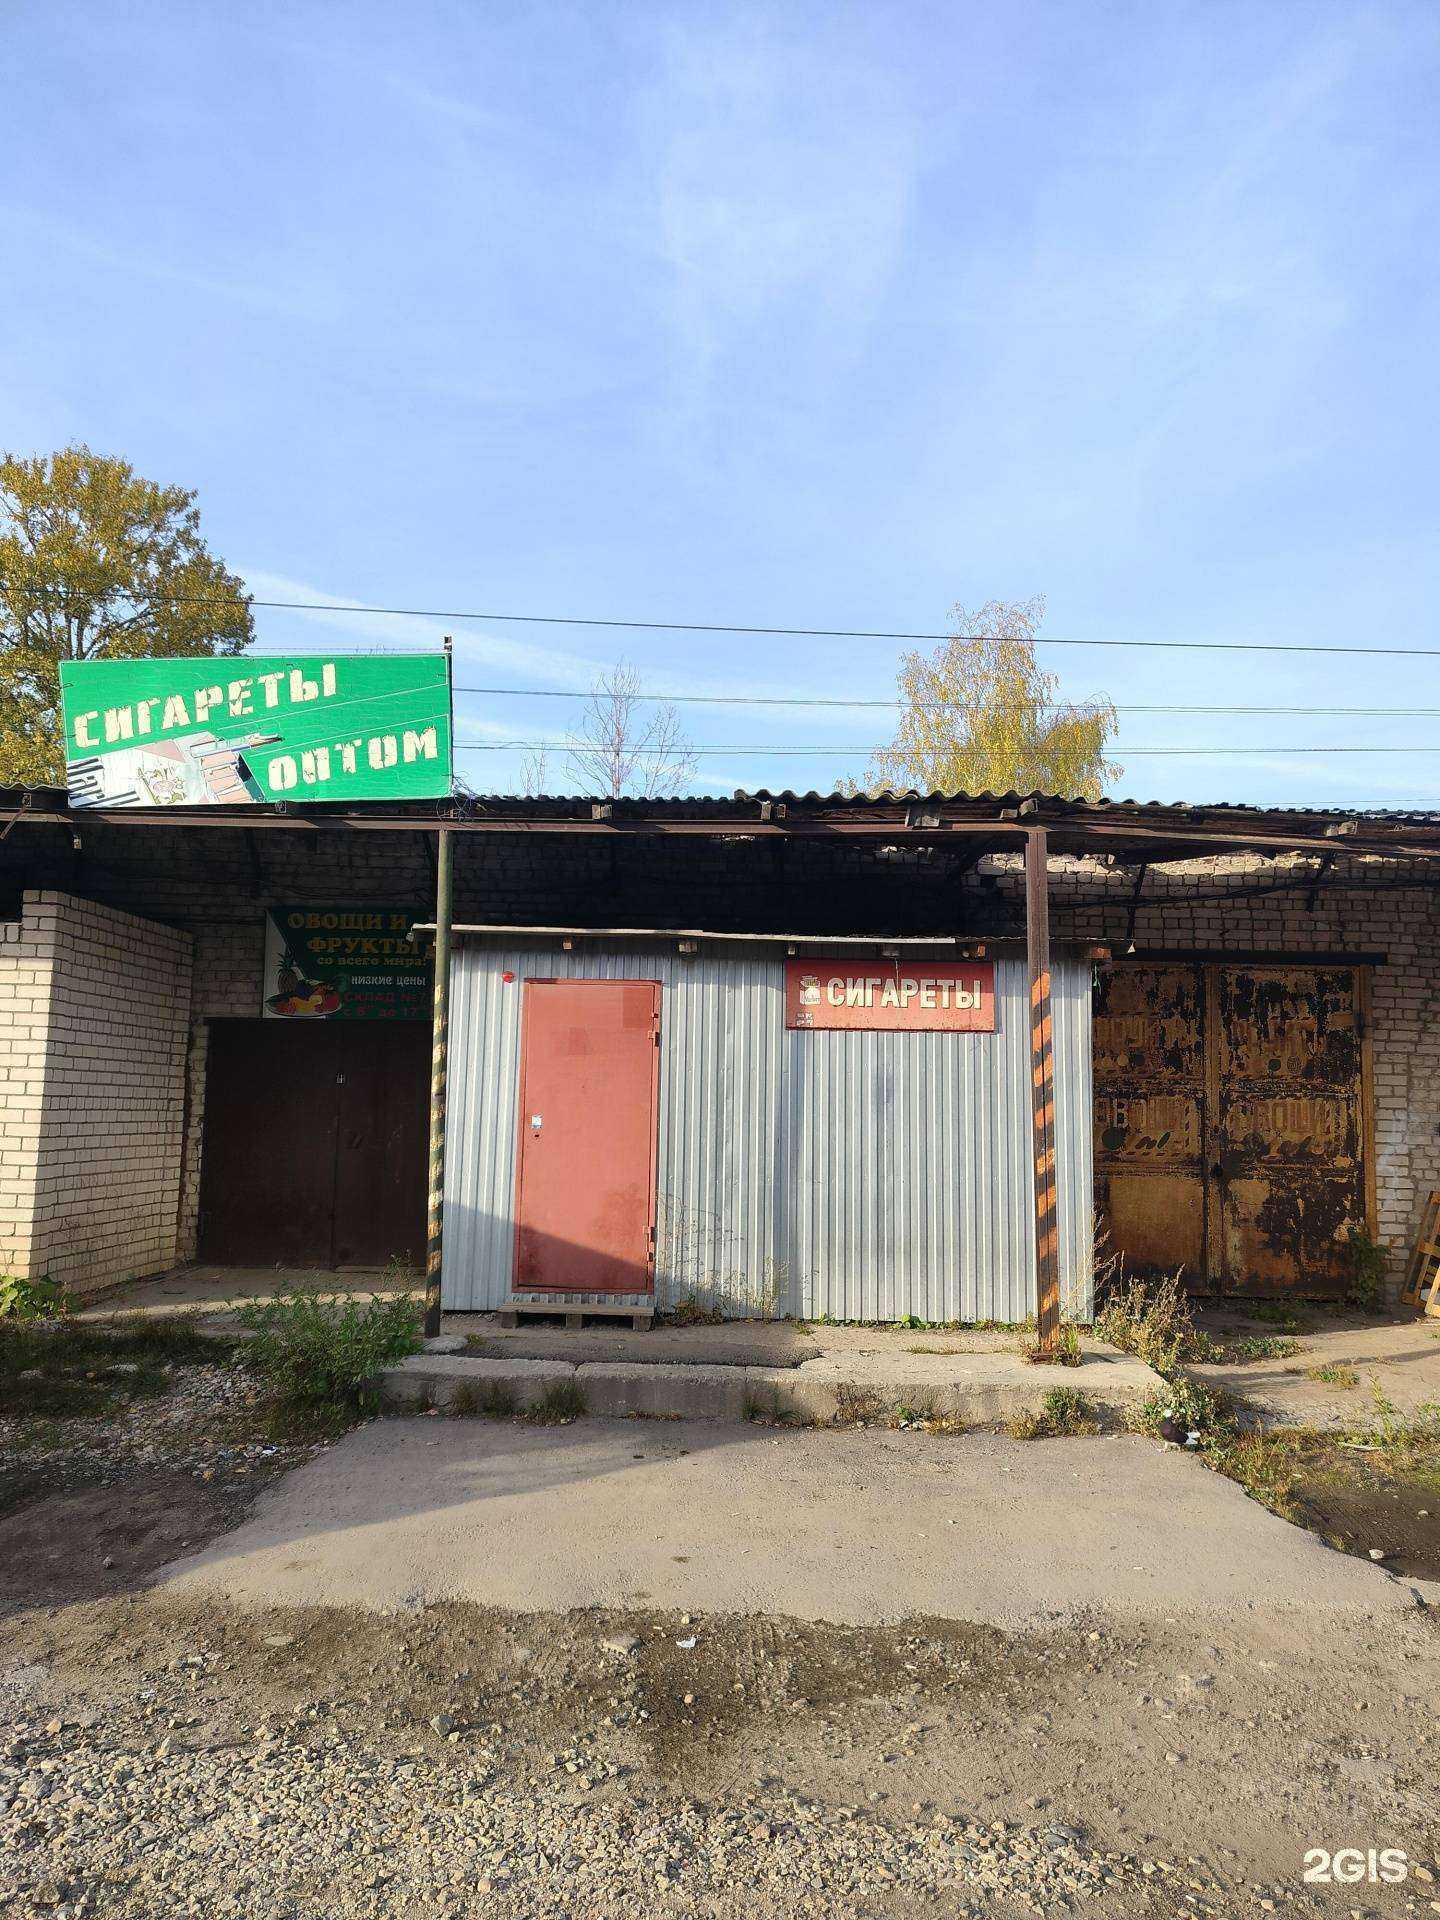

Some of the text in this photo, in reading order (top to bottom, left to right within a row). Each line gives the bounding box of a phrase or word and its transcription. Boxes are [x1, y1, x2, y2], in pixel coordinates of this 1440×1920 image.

[73, 663, 337, 749] СИГАРЕТЫ
[267, 726, 439, 792] ОПТОМ
[288, 912, 408, 930] ОВОЩИ И
[306, 936, 420, 954] ФРУКТЫ
[351, 975, 427, 987] низкие цены
[826, 977, 982, 1010] СИГАРЕТЫ
